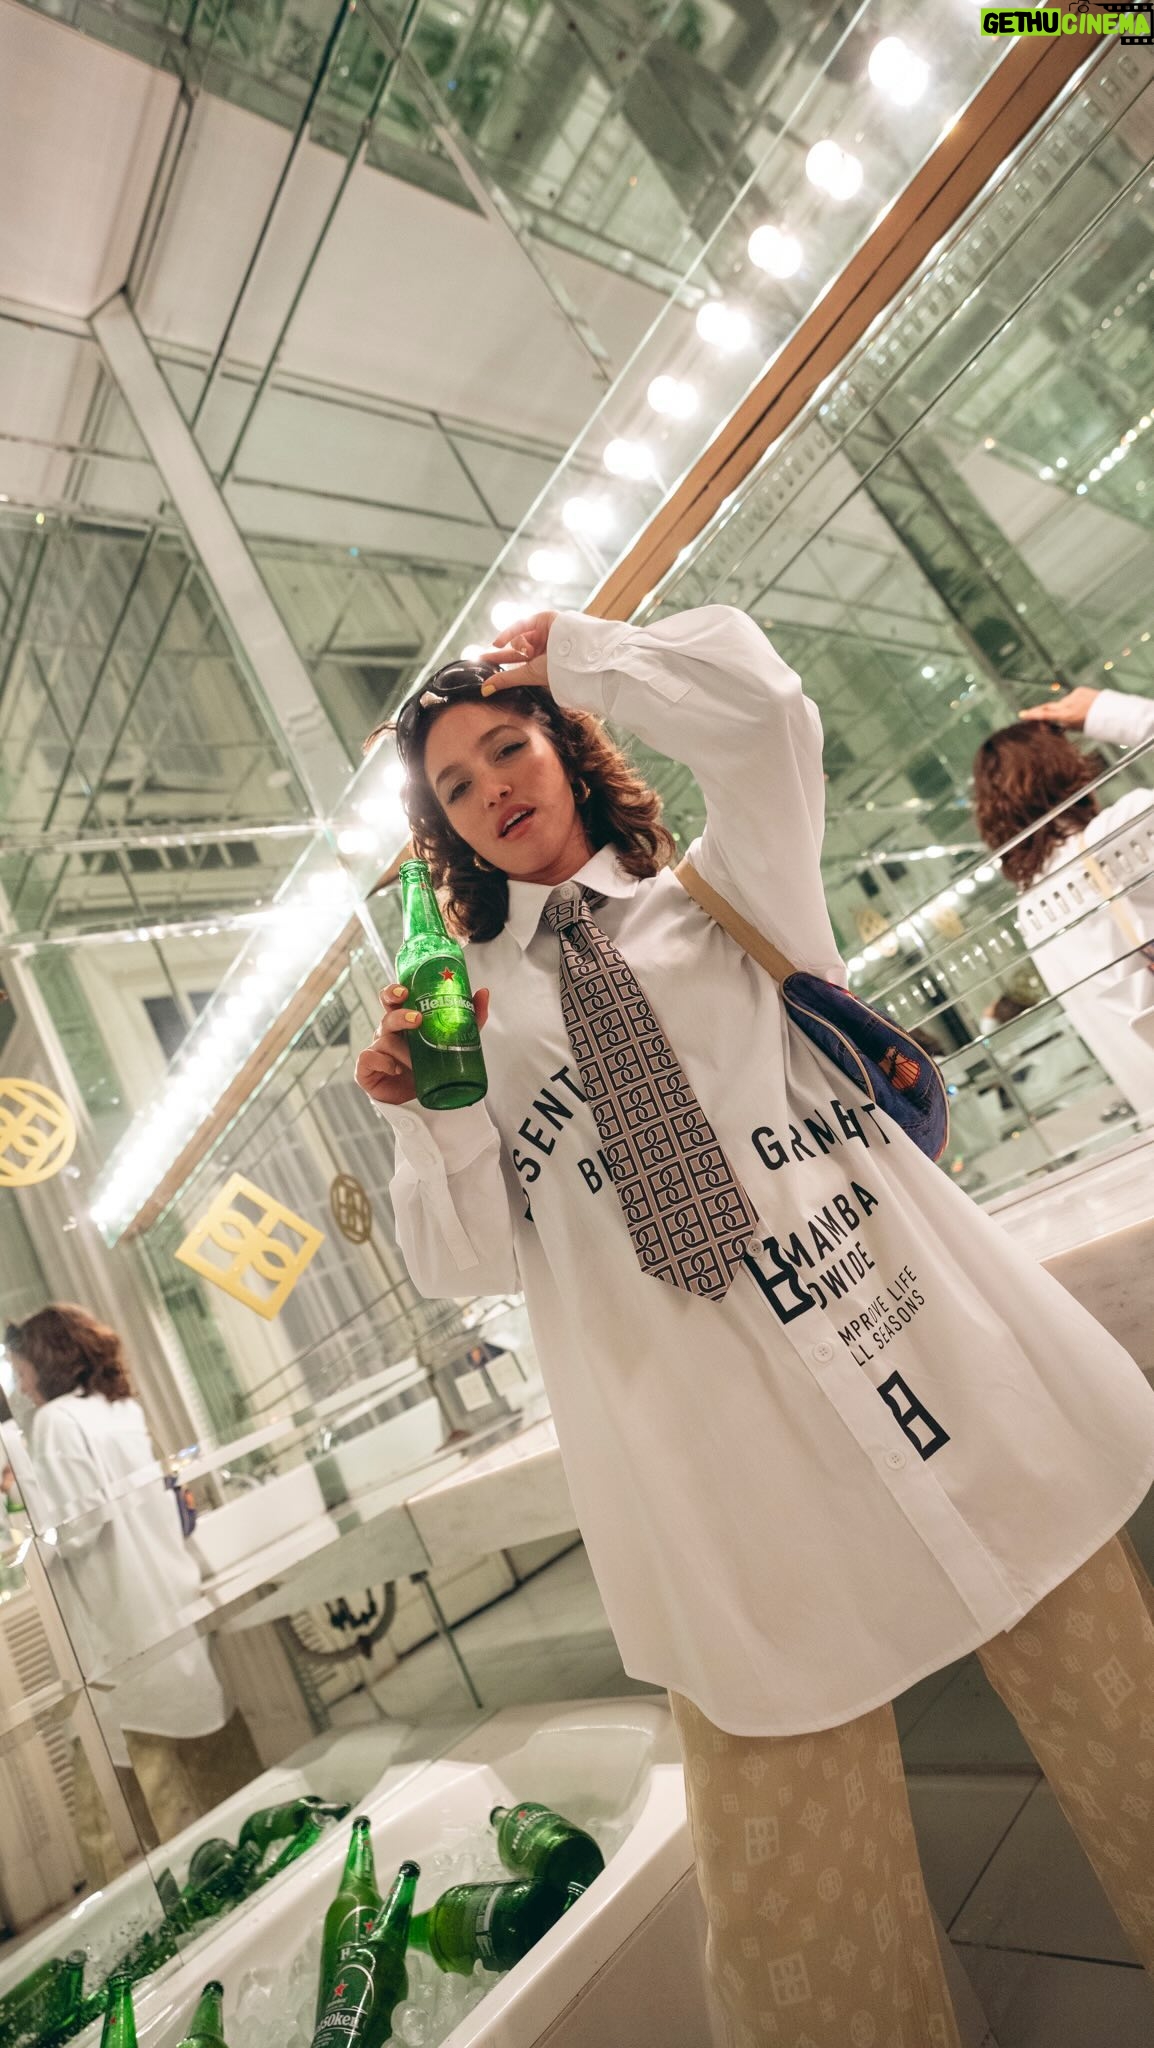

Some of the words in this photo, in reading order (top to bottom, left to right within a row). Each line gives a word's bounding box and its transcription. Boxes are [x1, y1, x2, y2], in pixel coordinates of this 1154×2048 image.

[512, 1065, 588, 1222] SENT
[886, 1265, 918, 1302] LIFE
[872, 1289, 926, 1350] SEASONS
